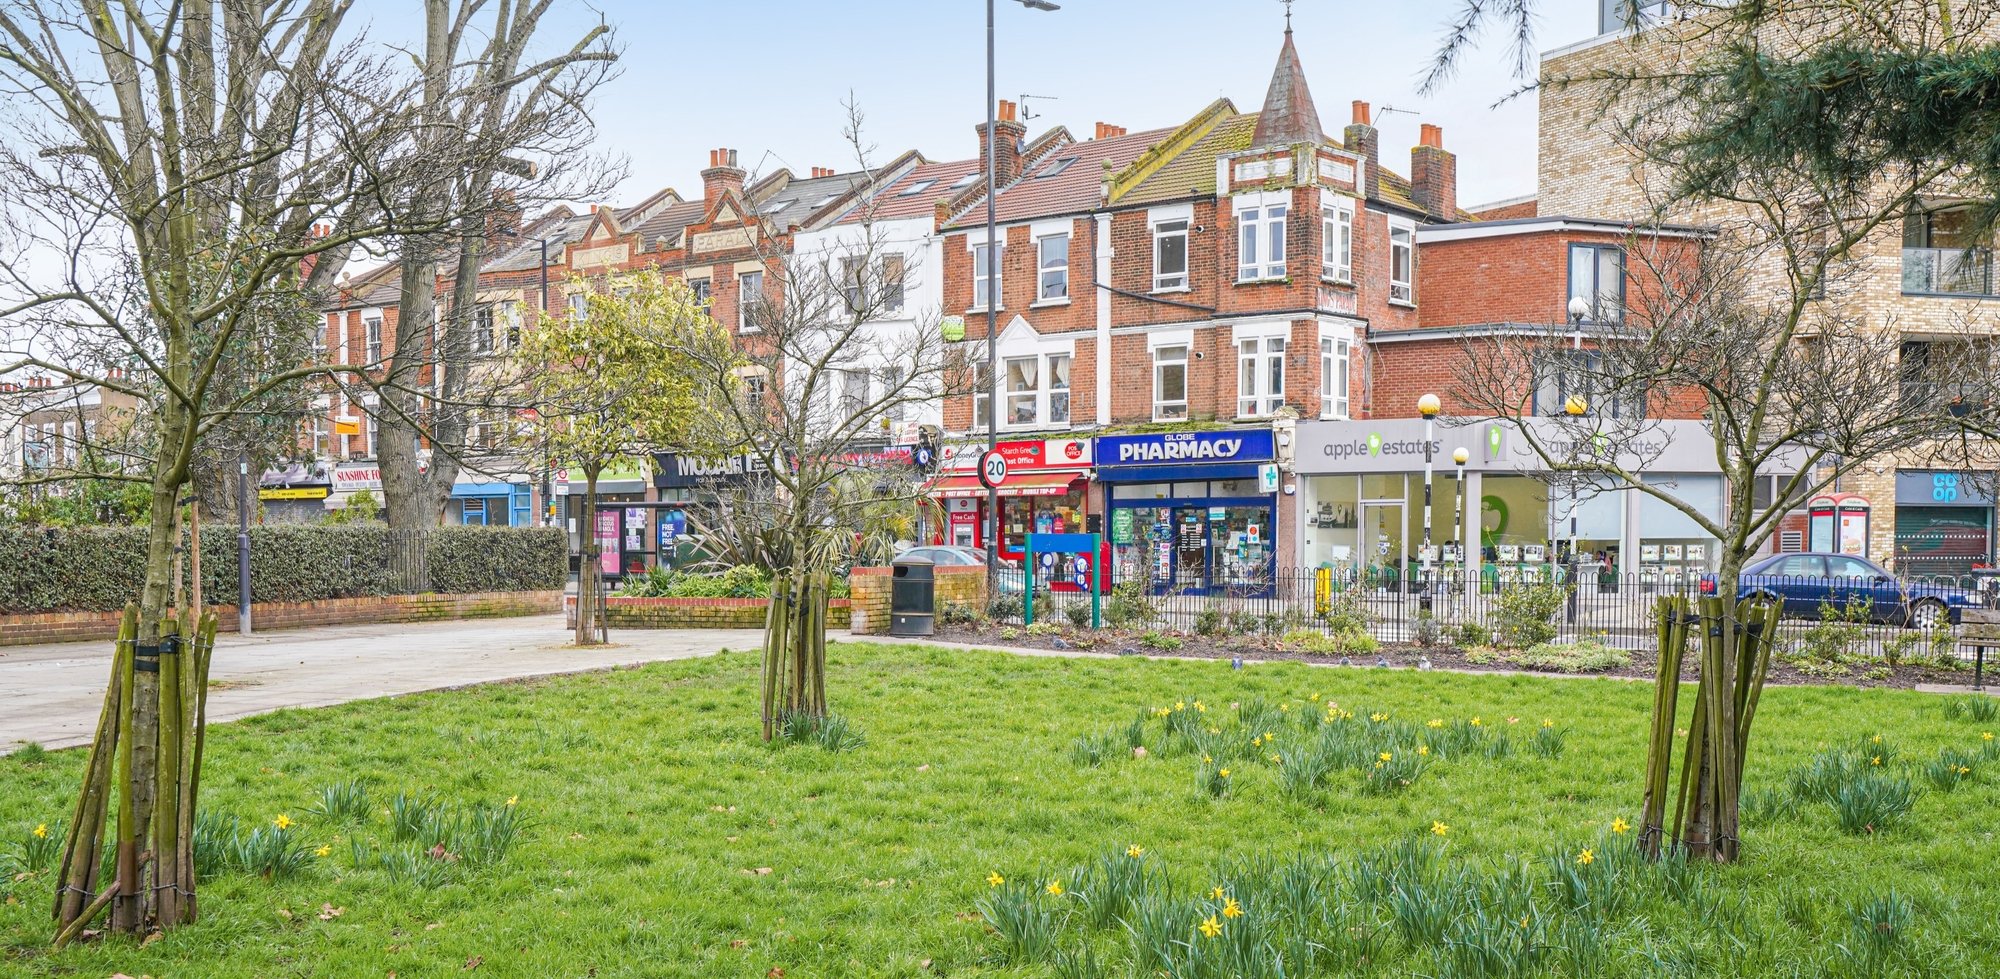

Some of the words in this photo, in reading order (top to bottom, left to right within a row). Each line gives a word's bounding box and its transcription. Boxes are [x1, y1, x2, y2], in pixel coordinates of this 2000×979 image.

[1164, 433, 1195, 441] GLOBE
[1002, 447, 1019, 455] Starch
[1020, 446, 1033, 455] Gree
[1119, 438, 1242, 461] PHARMACY
[1323, 439, 1368, 460] apple
[987, 460, 1005, 476] 20
[337, 470, 370, 482] SUNSHINE
